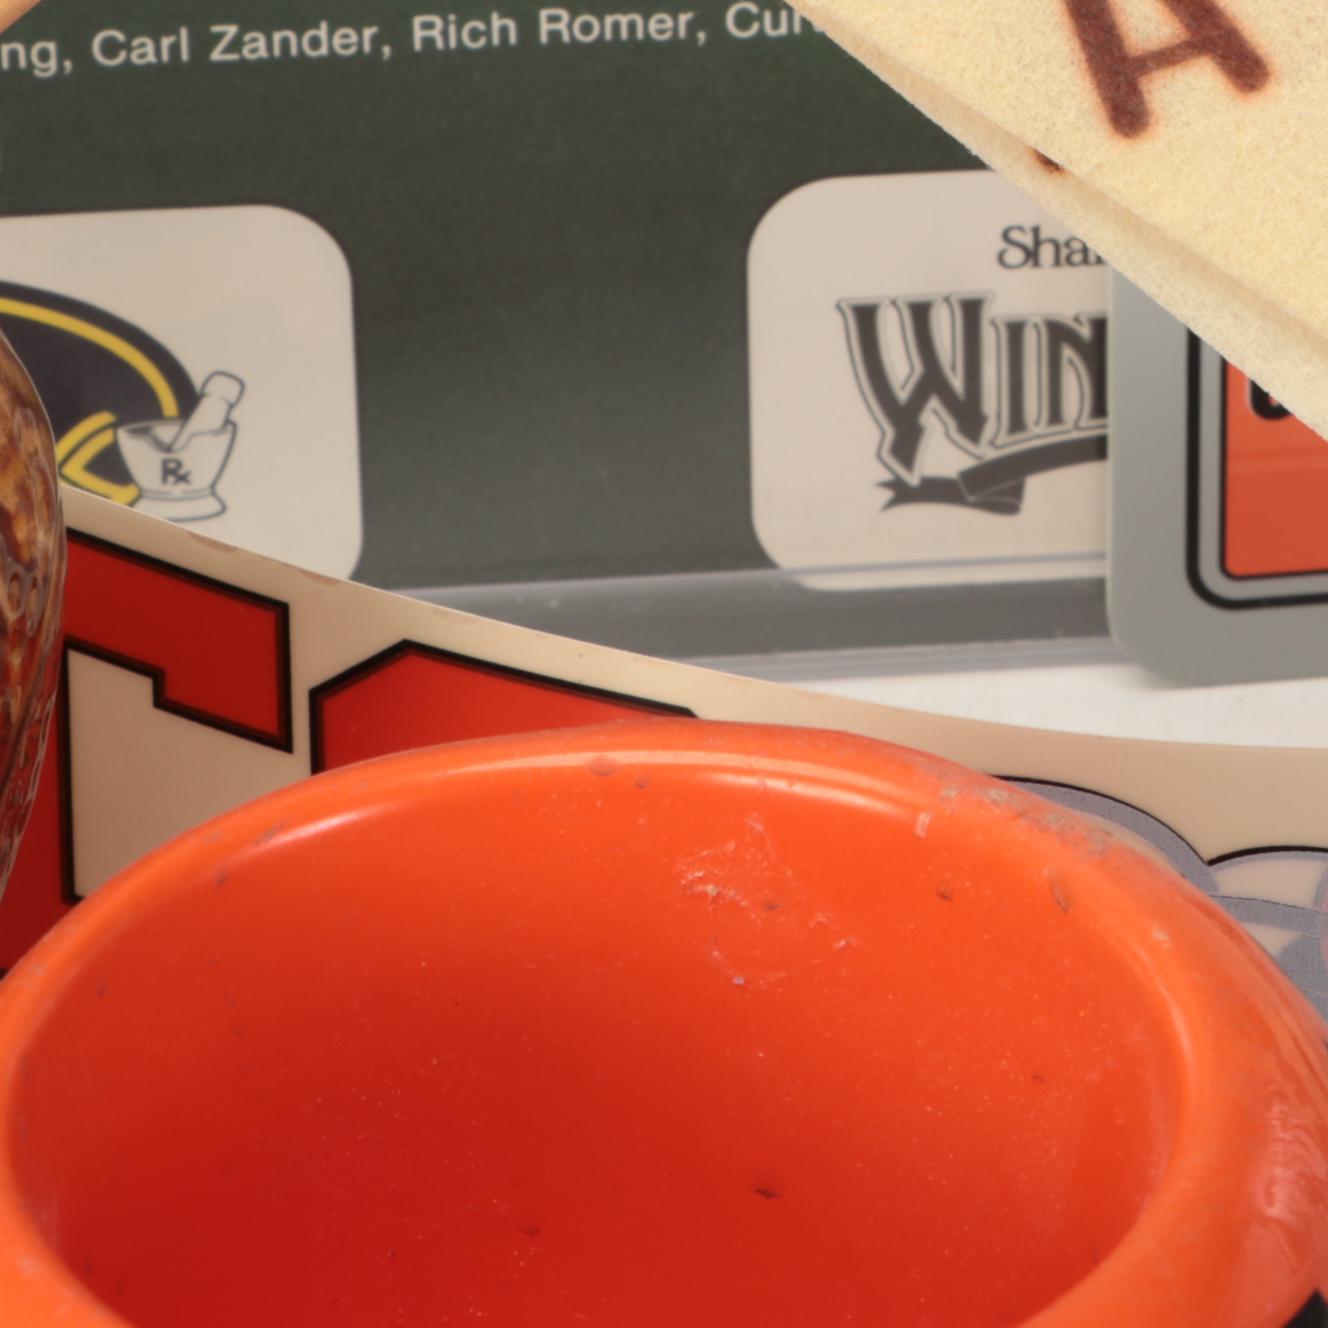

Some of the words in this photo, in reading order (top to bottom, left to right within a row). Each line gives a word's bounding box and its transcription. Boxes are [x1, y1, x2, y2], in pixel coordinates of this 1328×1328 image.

[1, 40, 73, 77] ng,
[92, 27, 190, 67] Carl
[209, 20, 391, 62] Zander,
[413, 13, 517, 51] Rich
[539, 7, 705, 46] Romer,
